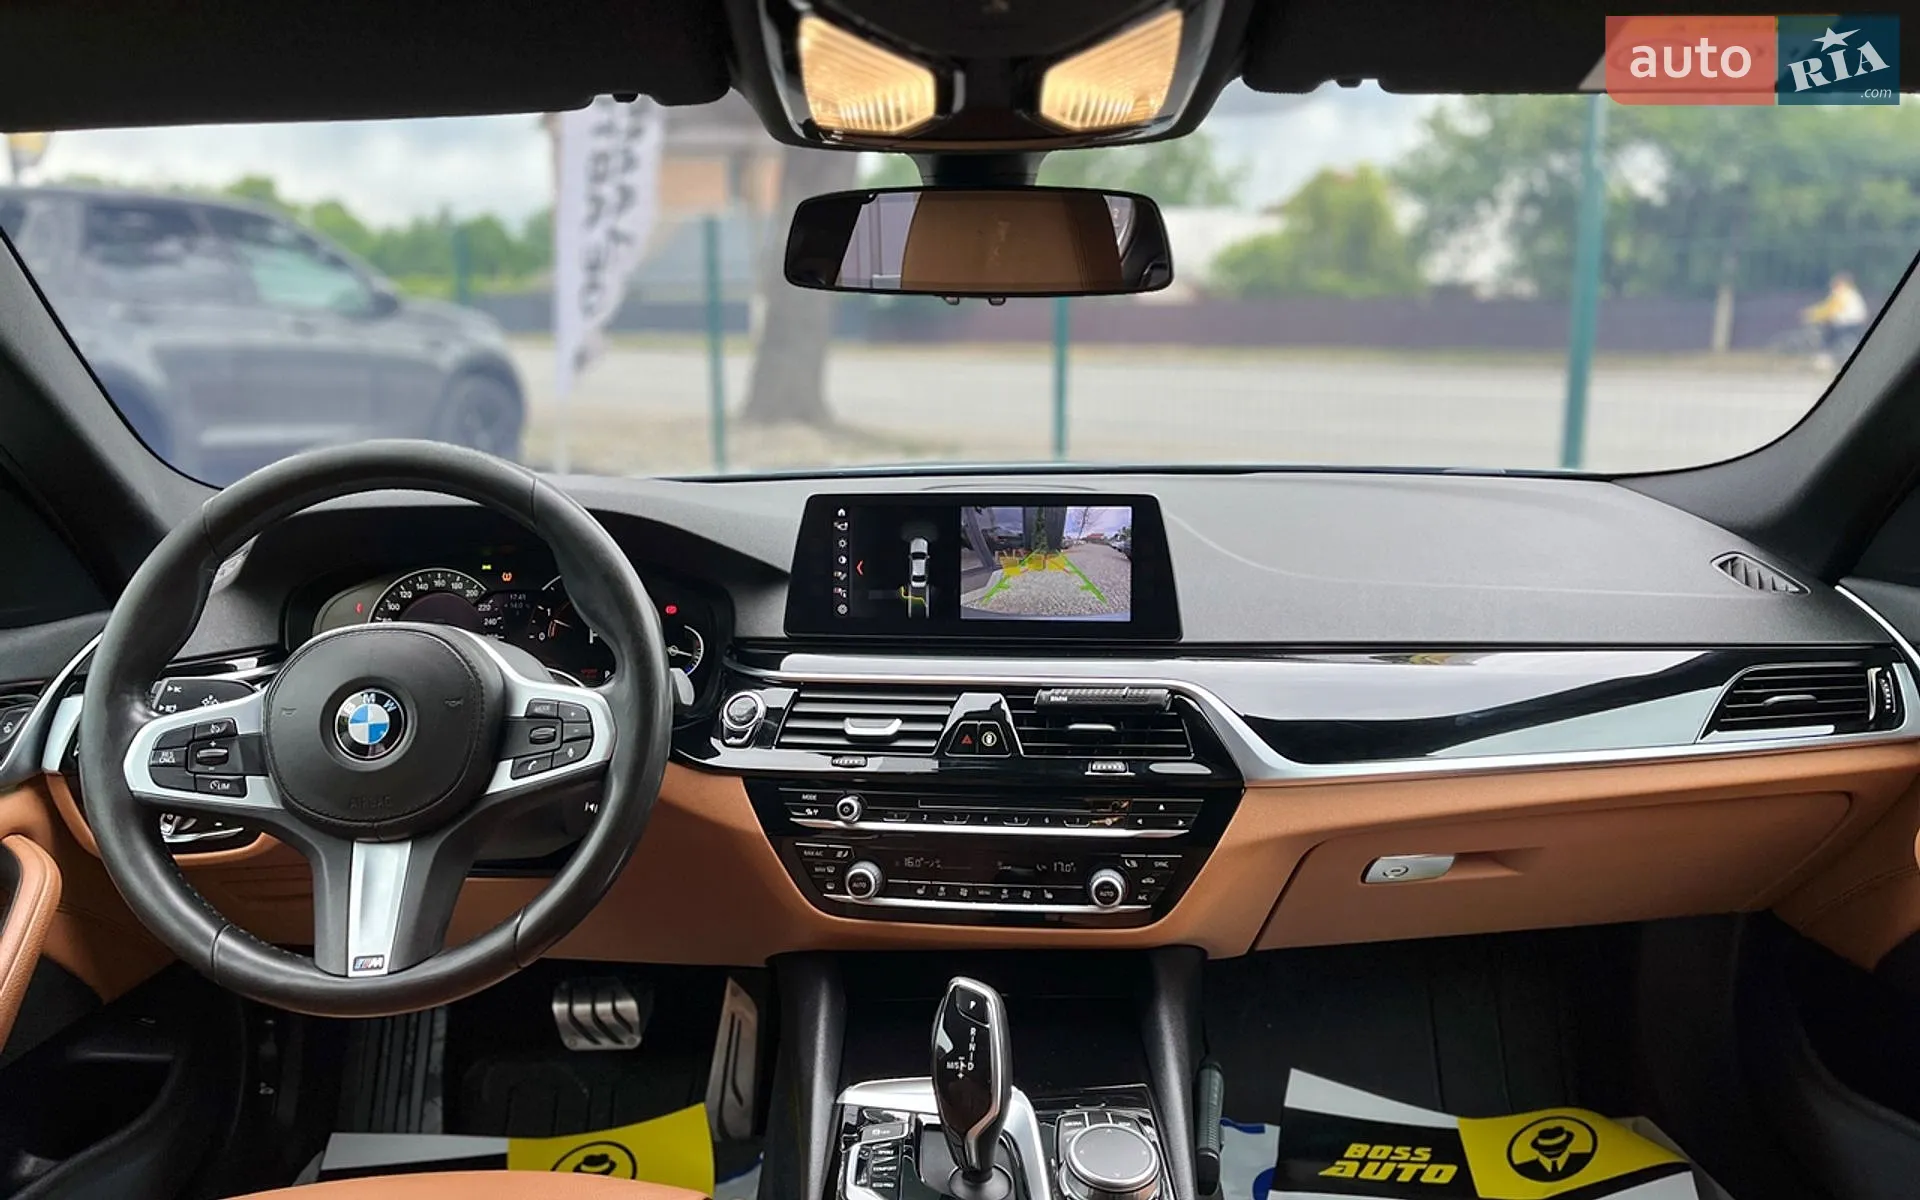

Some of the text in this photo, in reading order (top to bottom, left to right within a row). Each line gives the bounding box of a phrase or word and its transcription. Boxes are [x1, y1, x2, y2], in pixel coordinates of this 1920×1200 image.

[416, 583, 429, 591] 140
[451, 582, 463, 590] 180
[400, 590, 412, 599] 120
[466, 589, 479, 597] 200
[388, 603, 400, 611] 100
[484, 618, 497, 626] 240
[340, 692, 397, 717] BMW
[217, 782, 230, 790] LIM
[1099, 890, 1114, 898] AUTO
[969, 1000, 976, 1009] P
[967, 1027, 977, 1071] R N D
[1343, 1143, 1433, 1161] BOSS
[1317, 1160, 1459, 1184] AUTO
